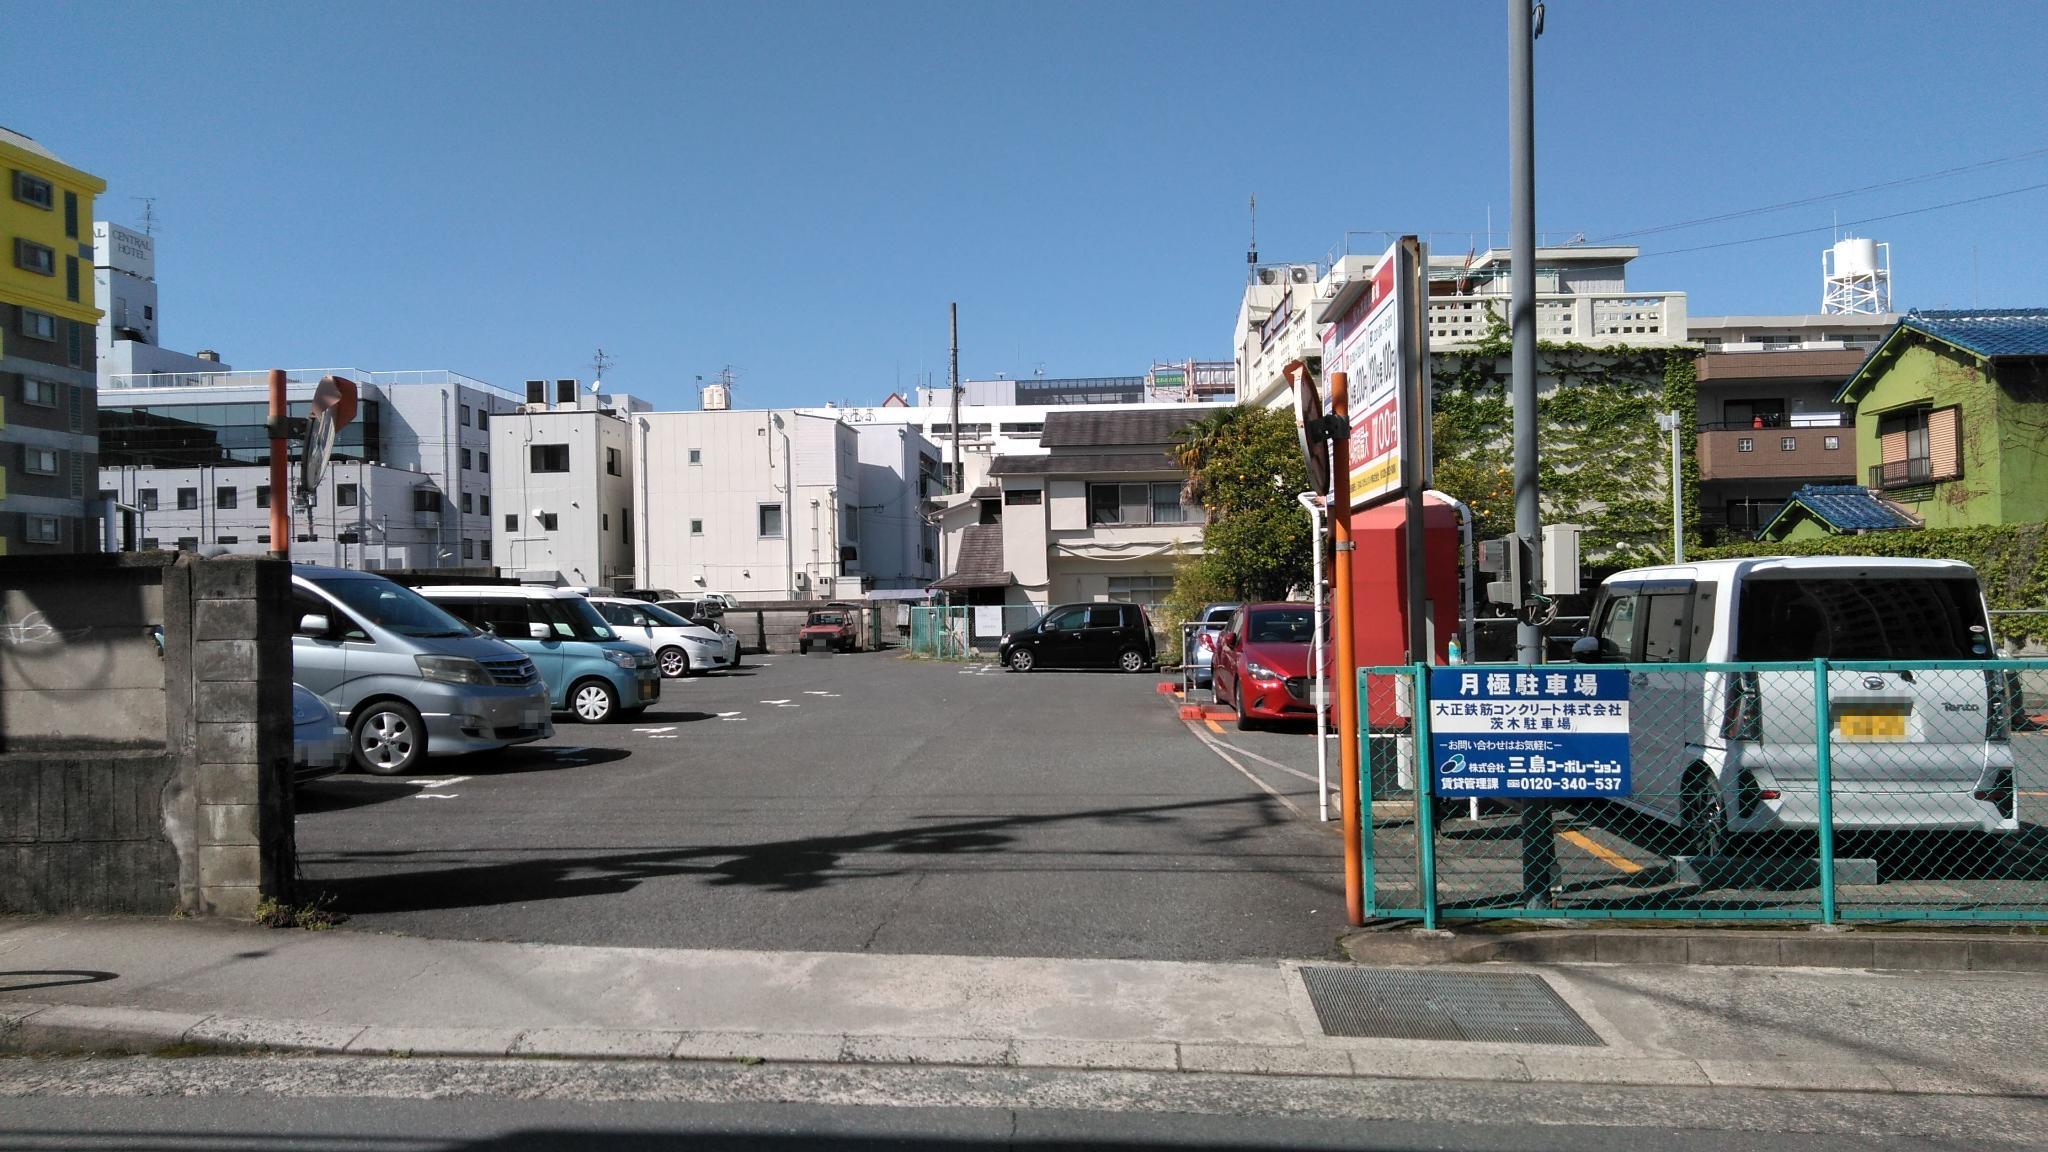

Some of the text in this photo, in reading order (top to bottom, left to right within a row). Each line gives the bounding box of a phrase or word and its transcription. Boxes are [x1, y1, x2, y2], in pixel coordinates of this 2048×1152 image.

[112, 230, 151, 251] CENTRAL
[118, 243, 147, 260] HOTEL
[1460, 673, 1598, 696] 月極駐車場
[1436, 703, 1622, 716] 大正鉄筋コンクリート株式会社
[1941, 702, 1979, 712] Tanto
[1490, 717, 1571, 730] 茨木駐車場
[1441, 778, 1621, 790] 賃貸管理課 0120-340-537
